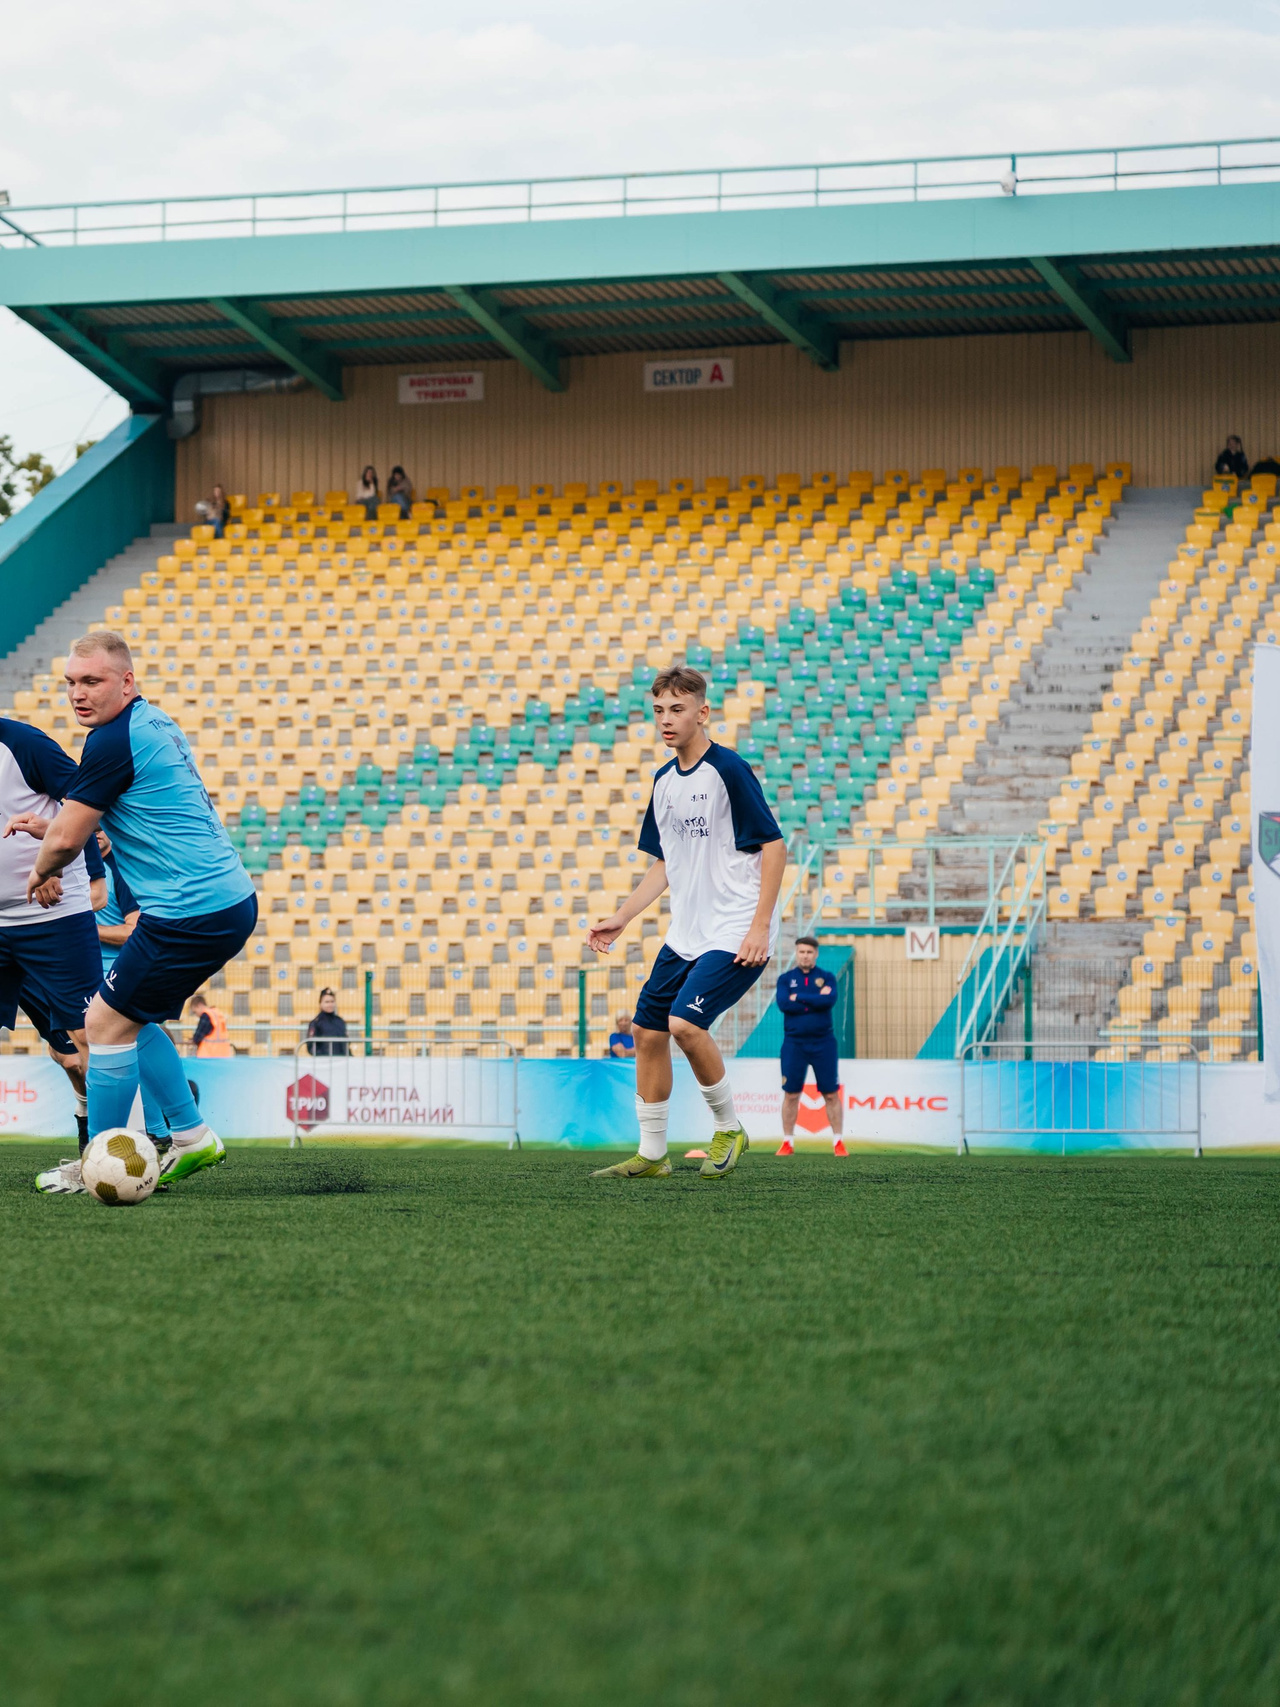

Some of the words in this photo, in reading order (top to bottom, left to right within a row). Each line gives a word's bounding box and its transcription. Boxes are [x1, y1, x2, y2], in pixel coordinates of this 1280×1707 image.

[652, 367, 702, 386] СЕКТОР
[709, 363, 724, 384] А
[347, 1086, 421, 1102] ГРУППА
[289, 1096, 327, 1112] ТРИО
[848, 1095, 949, 1112] МАКС
[347, 1104, 454, 1123] КОМПАНИЙ
